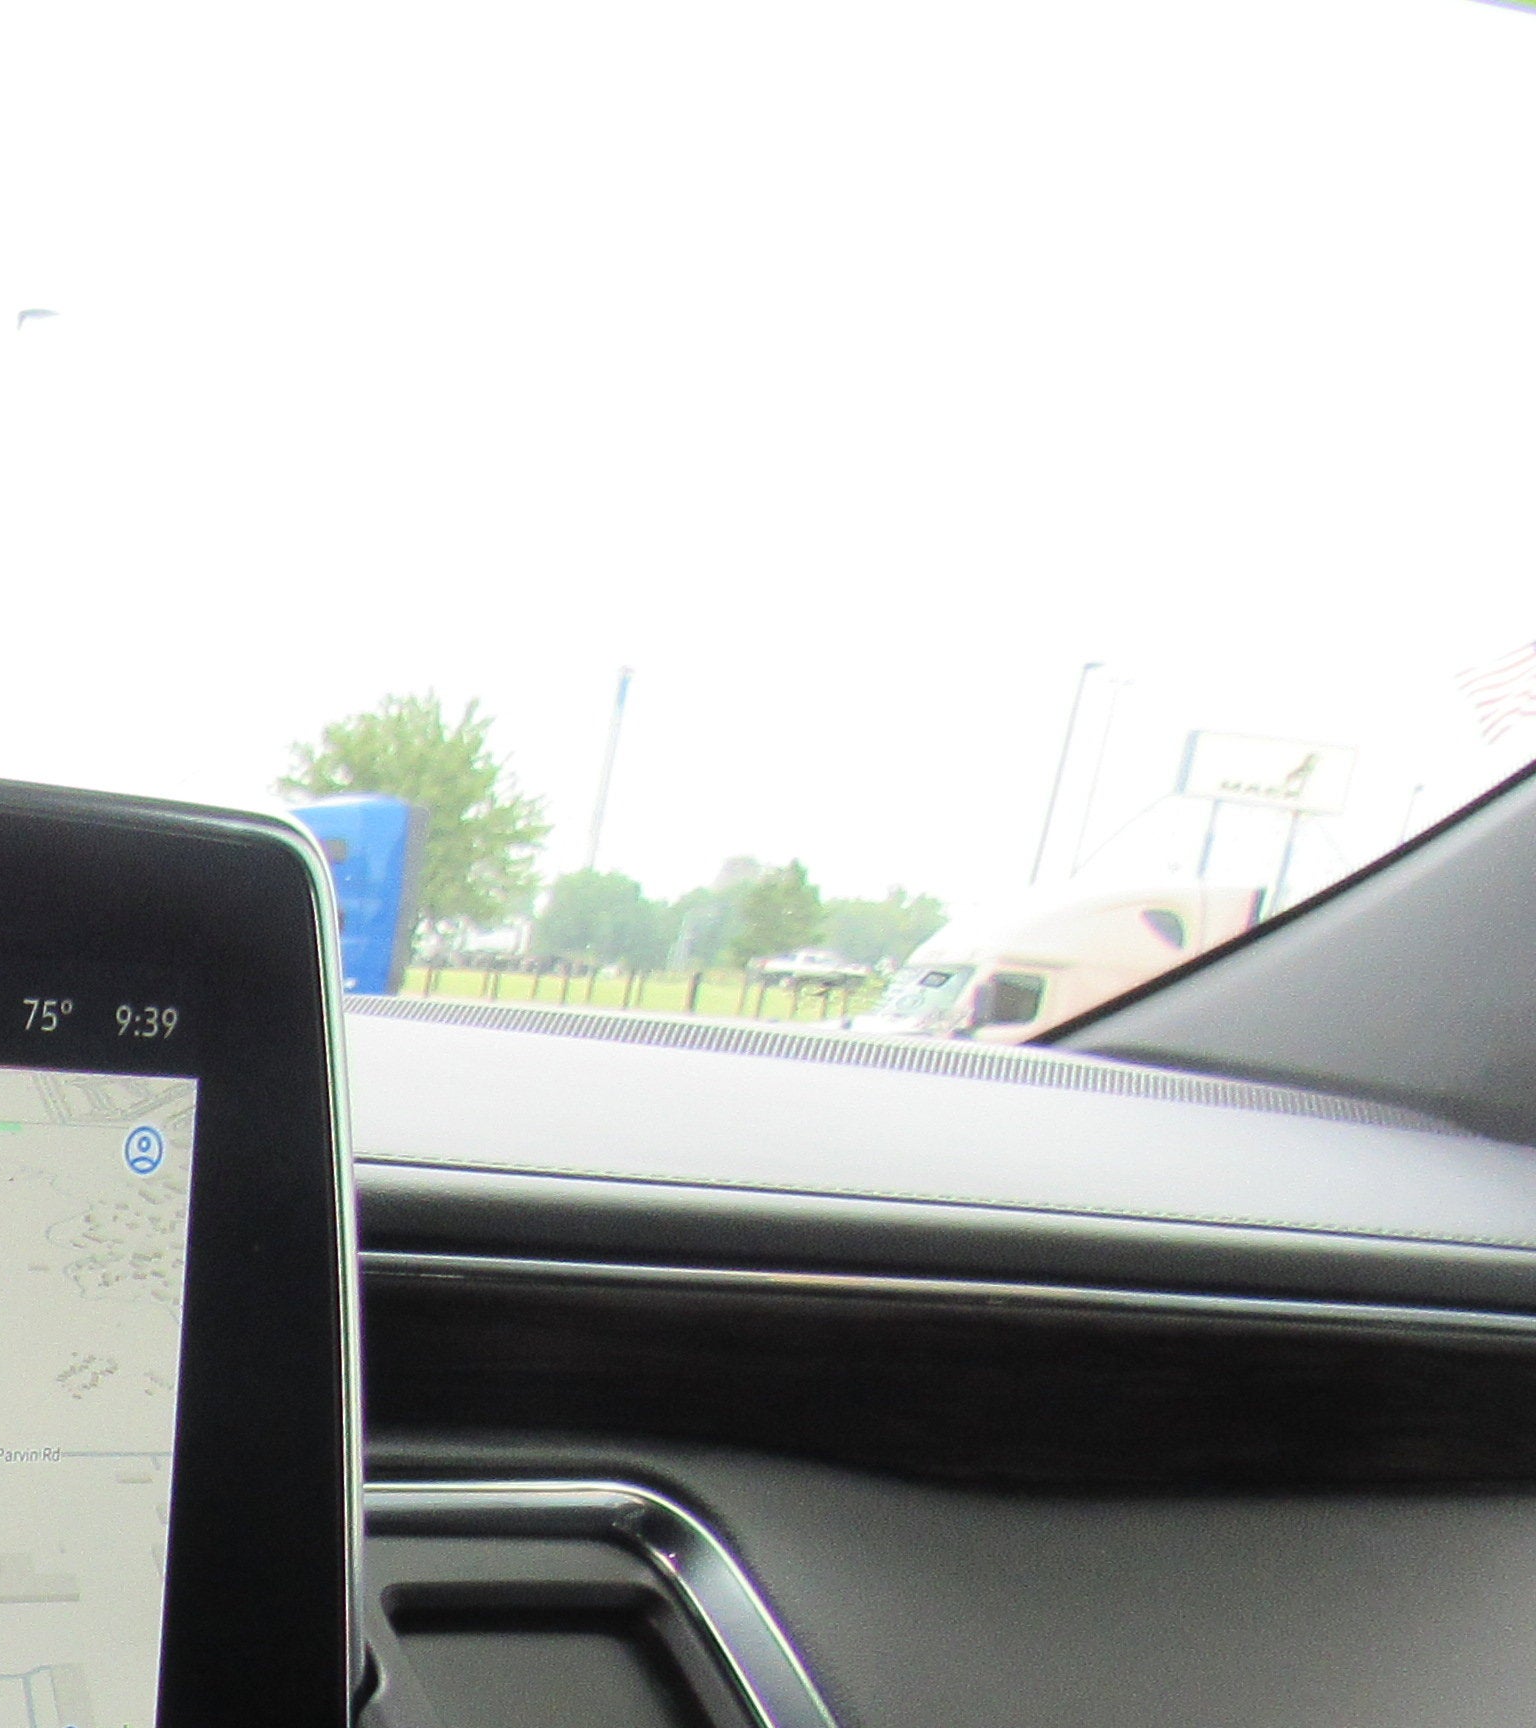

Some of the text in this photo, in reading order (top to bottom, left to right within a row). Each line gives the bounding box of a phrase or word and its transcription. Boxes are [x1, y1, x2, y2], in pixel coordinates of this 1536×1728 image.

[22, 998, 73, 1032] 75°
[115, 1004, 178, 1038] 9:39
[42, 1447, 60, 1462] Rd
